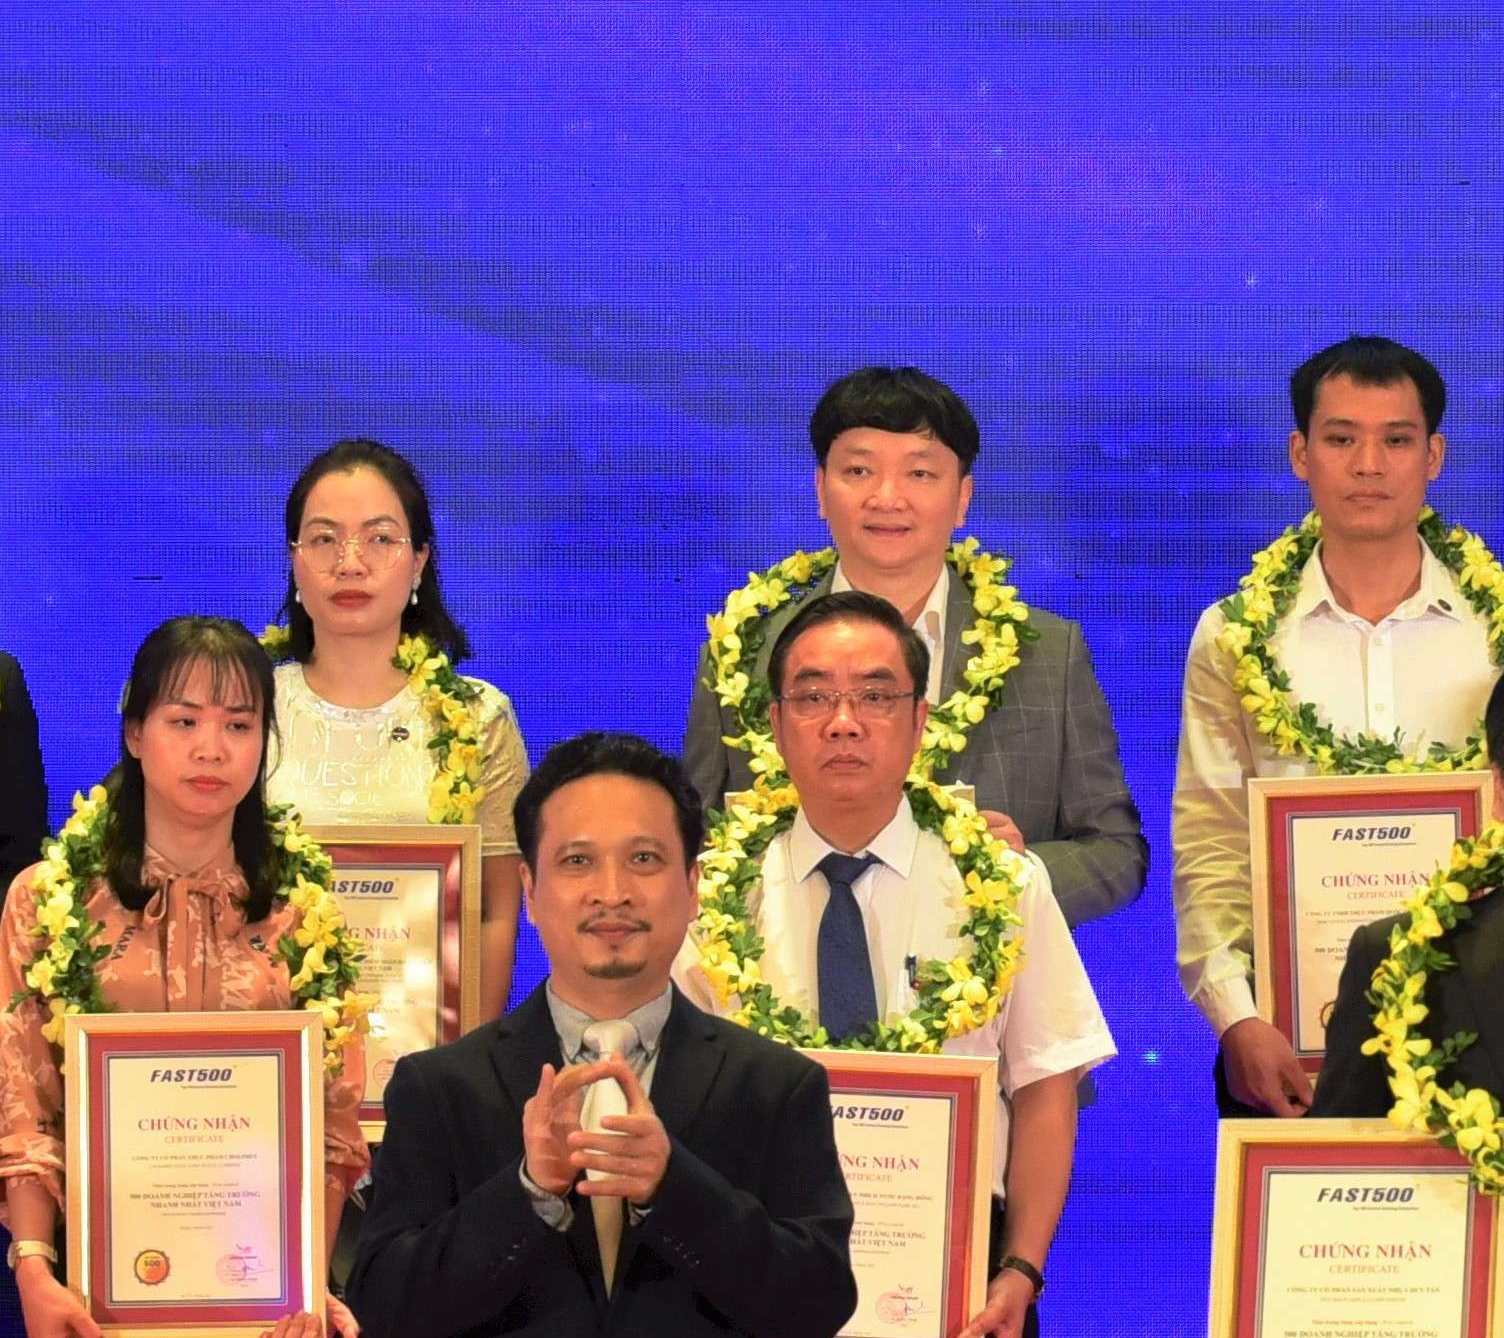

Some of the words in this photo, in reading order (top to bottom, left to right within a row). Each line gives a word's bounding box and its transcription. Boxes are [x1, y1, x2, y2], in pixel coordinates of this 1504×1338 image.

[1332, 827, 1411, 841] FAST500
[331, 881, 394, 893] ST500
[1321, 872, 1378, 887] CHỨNG
[150, 1068, 232, 1083] FAST500
[830, 1106, 904, 1121] AST500
[138, 1116, 198, 1131] CHỨNG
[204, 1117, 251, 1133] NHẬN
[872, 1155, 919, 1172] NHẬN
[845, 1173, 892, 1181] RTIFICATE
[1317, 1187, 1414, 1203] FAST500
[1299, 1241, 1369, 1259] CHỨNG
[1376, 1241, 1432, 1261] NHẬN
